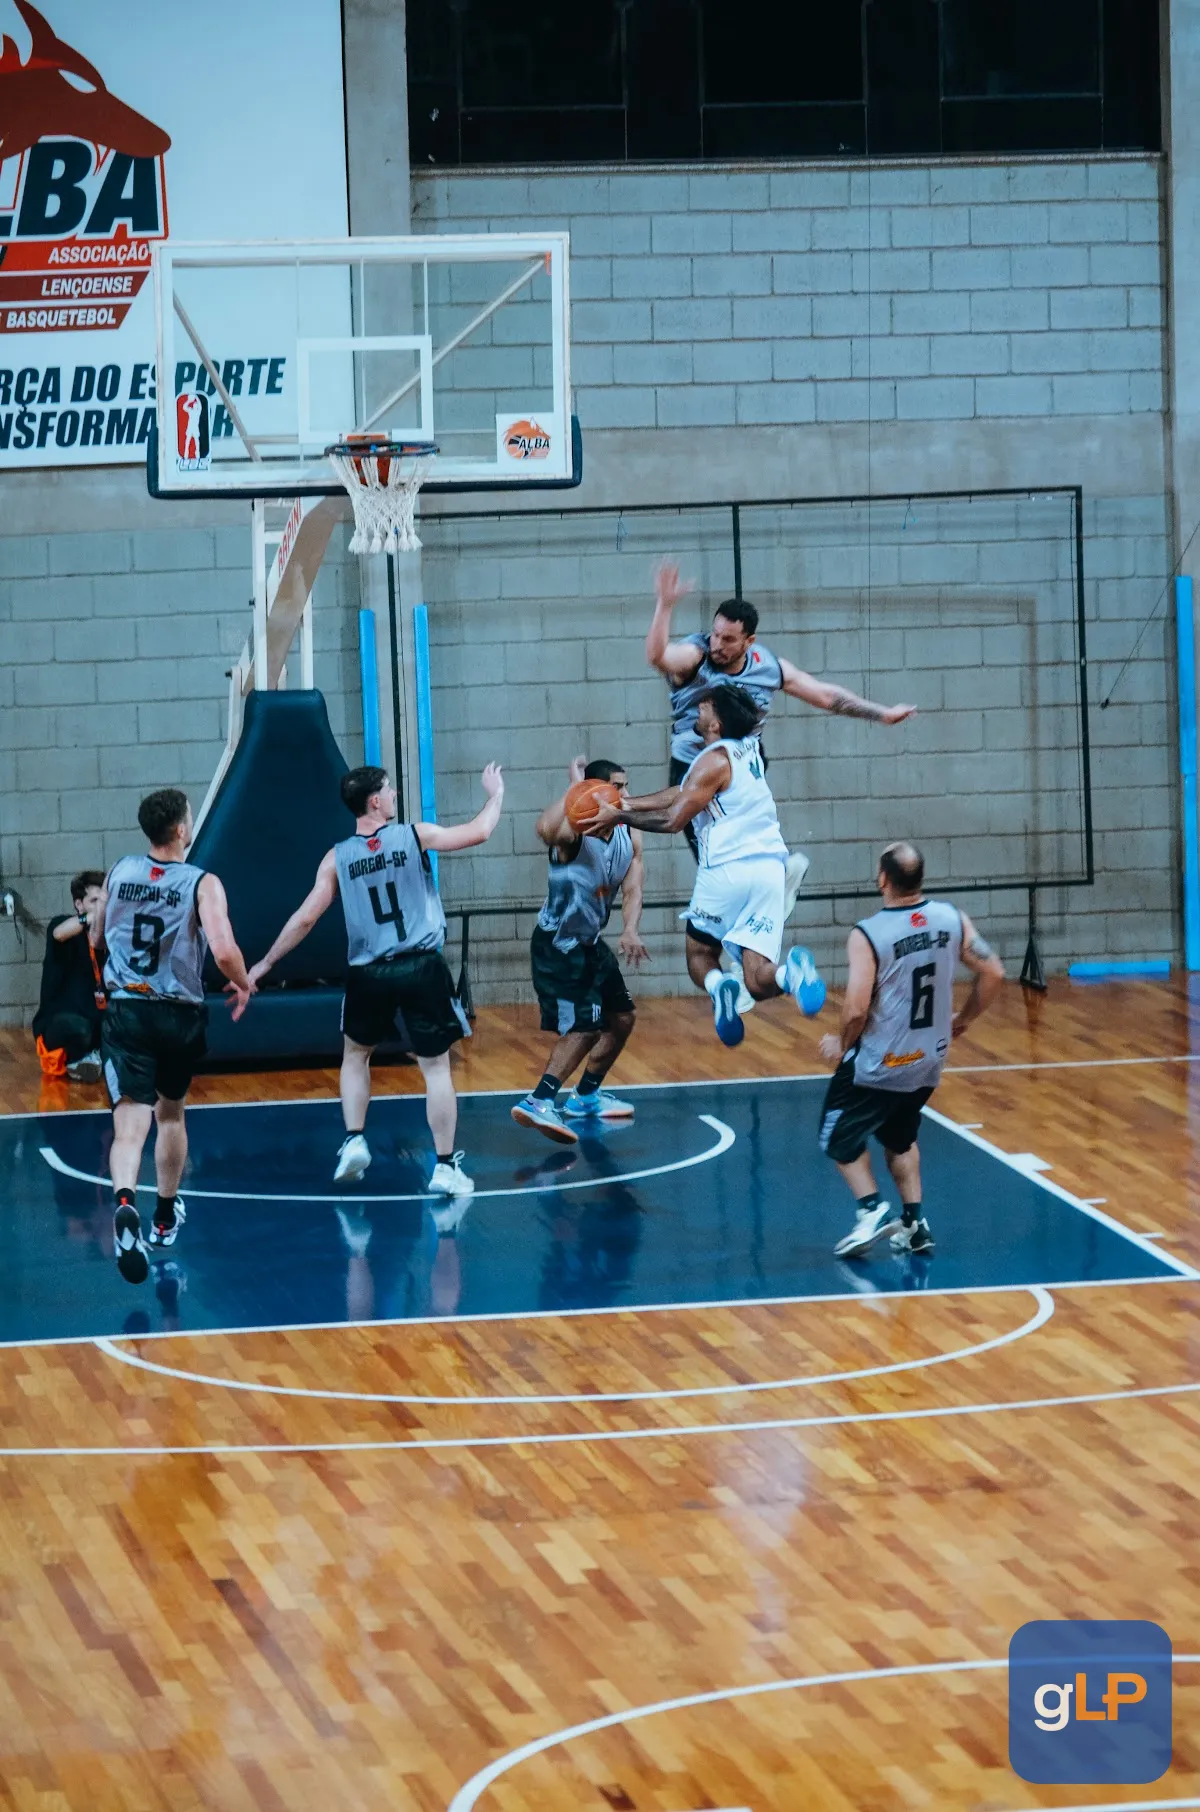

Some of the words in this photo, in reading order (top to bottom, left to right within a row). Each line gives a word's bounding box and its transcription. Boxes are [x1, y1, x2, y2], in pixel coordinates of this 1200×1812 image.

[48, 240, 150, 266] ASSOCIAÇÃO
[41, 276, 133, 298] LENÇOENSE
[6, 307, 116, 329] BASQUETEBOL
[70, 364, 121, 403] DO
[519, 437, 550, 449] ALBA
[368, 881, 407, 942] 4
[128, 913, 165, 976] 9
[910, 962, 937, 1030] 6
